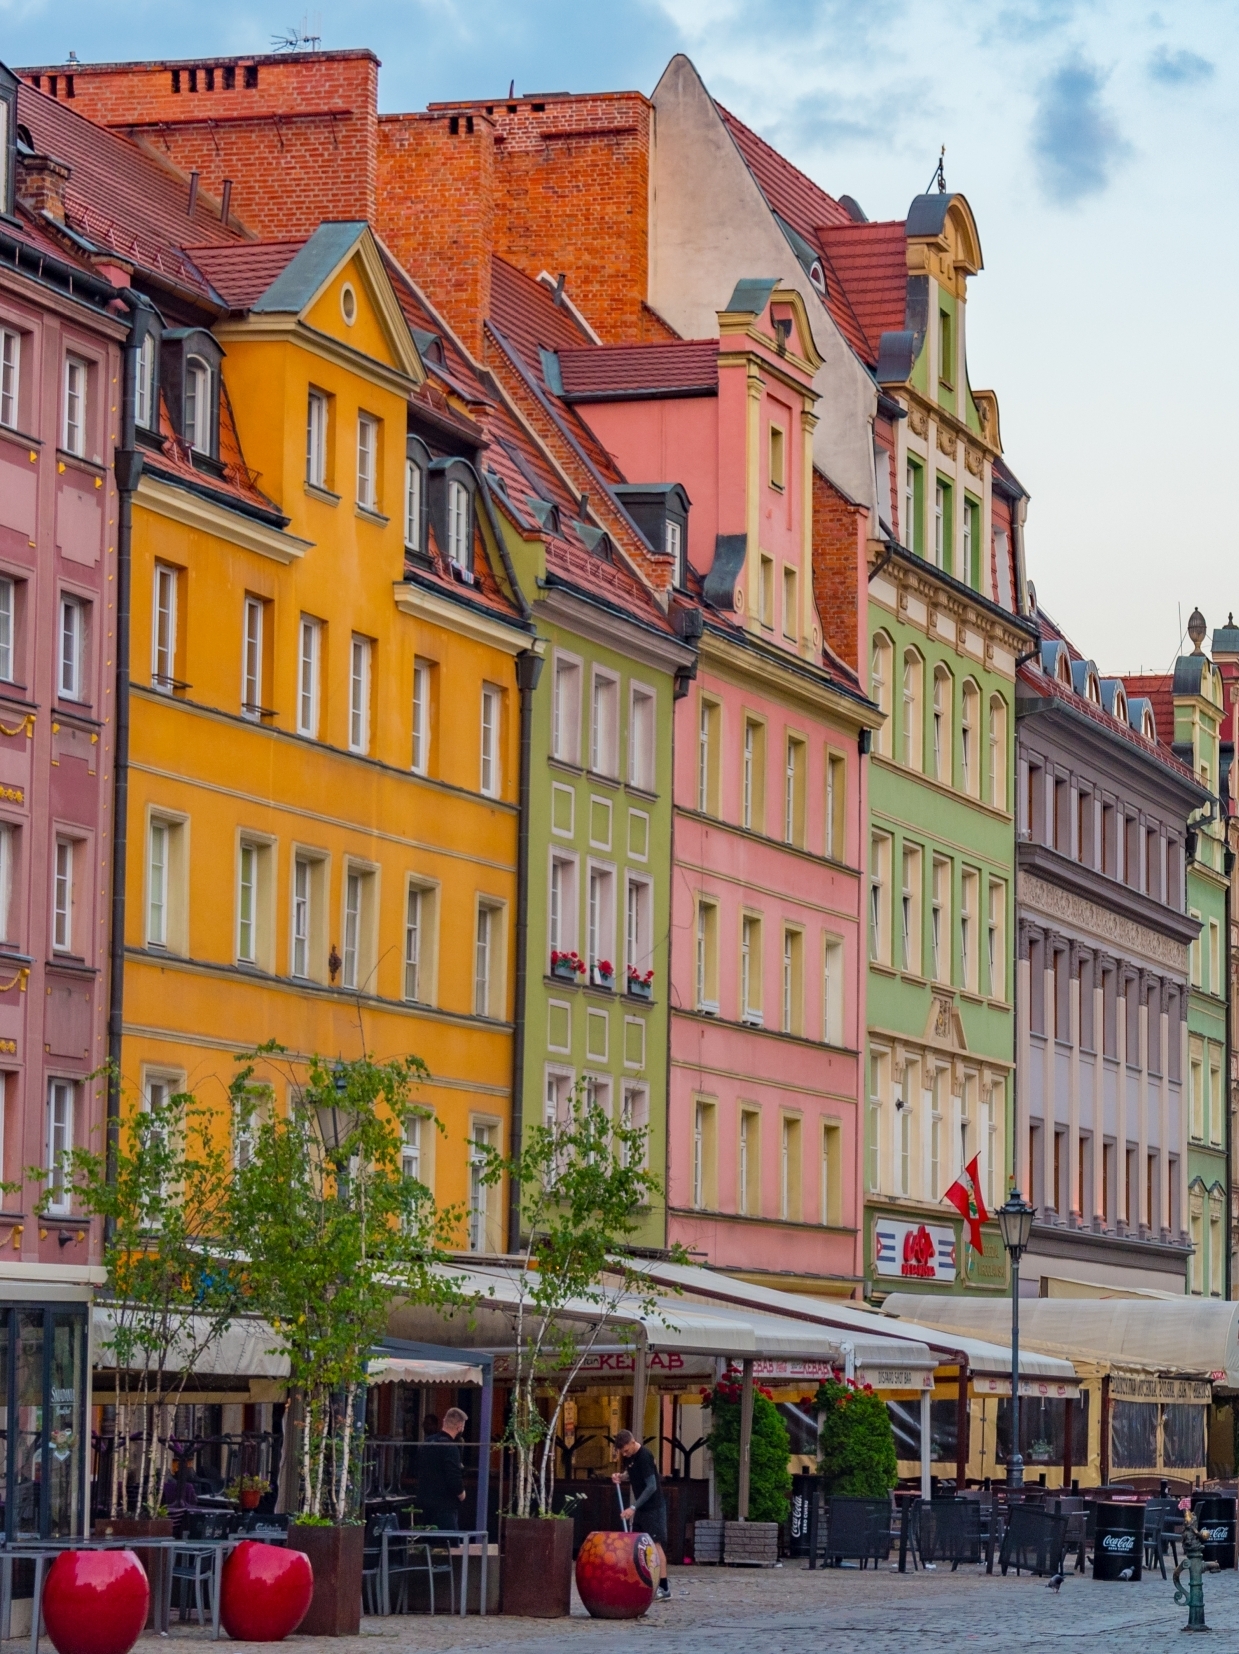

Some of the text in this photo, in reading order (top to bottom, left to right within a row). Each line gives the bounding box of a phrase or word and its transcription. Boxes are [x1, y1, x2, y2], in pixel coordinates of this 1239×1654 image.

[599, 1352, 685, 1372] KEAB
[753, 1360, 774, 1376] EBAB
[792, 1495, 802, 1537] Coca-Cola
[255, 1522, 282, 1532] Carlsberg
[1102, 1534, 1136, 1548] Coca-Cola
